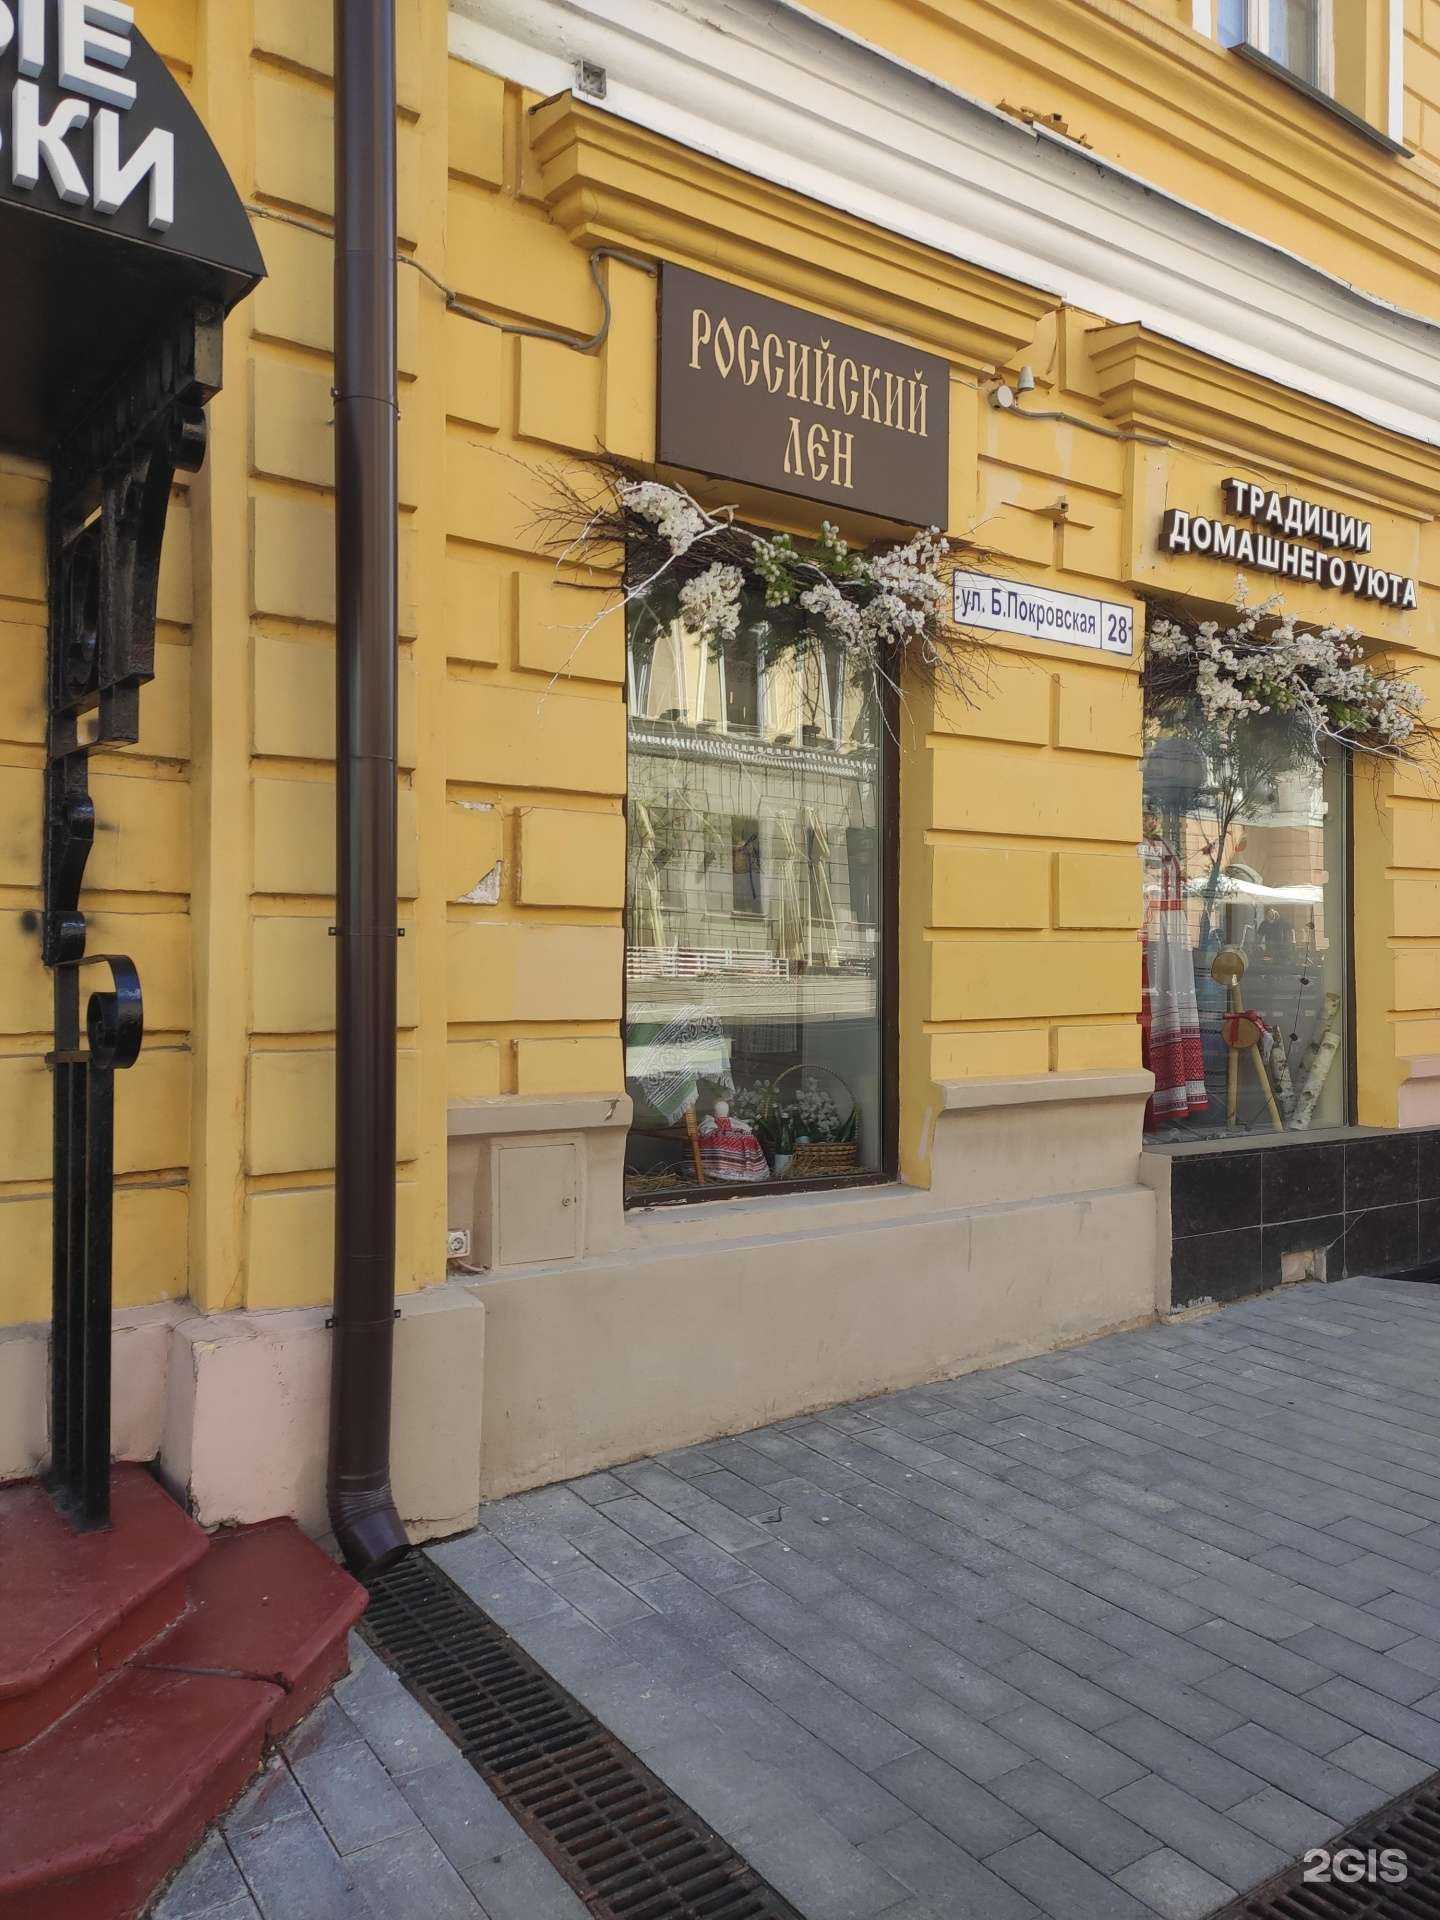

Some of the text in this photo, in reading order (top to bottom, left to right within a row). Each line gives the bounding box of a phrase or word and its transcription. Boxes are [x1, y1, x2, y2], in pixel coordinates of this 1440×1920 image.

[0, 79, 174, 233] КИ
[689, 308, 928, 437] РОССИЙСКИЙ
[784, 416, 854, 489] ЛЕН
[1231, 479, 1372, 551] ТРАДИЦИИ
[1168, 511, 1417, 608] ДОМАШНЕГО УЮТА
[961, 588, 985, 617] ул.
[1107, 613, 1128, 644] 28
